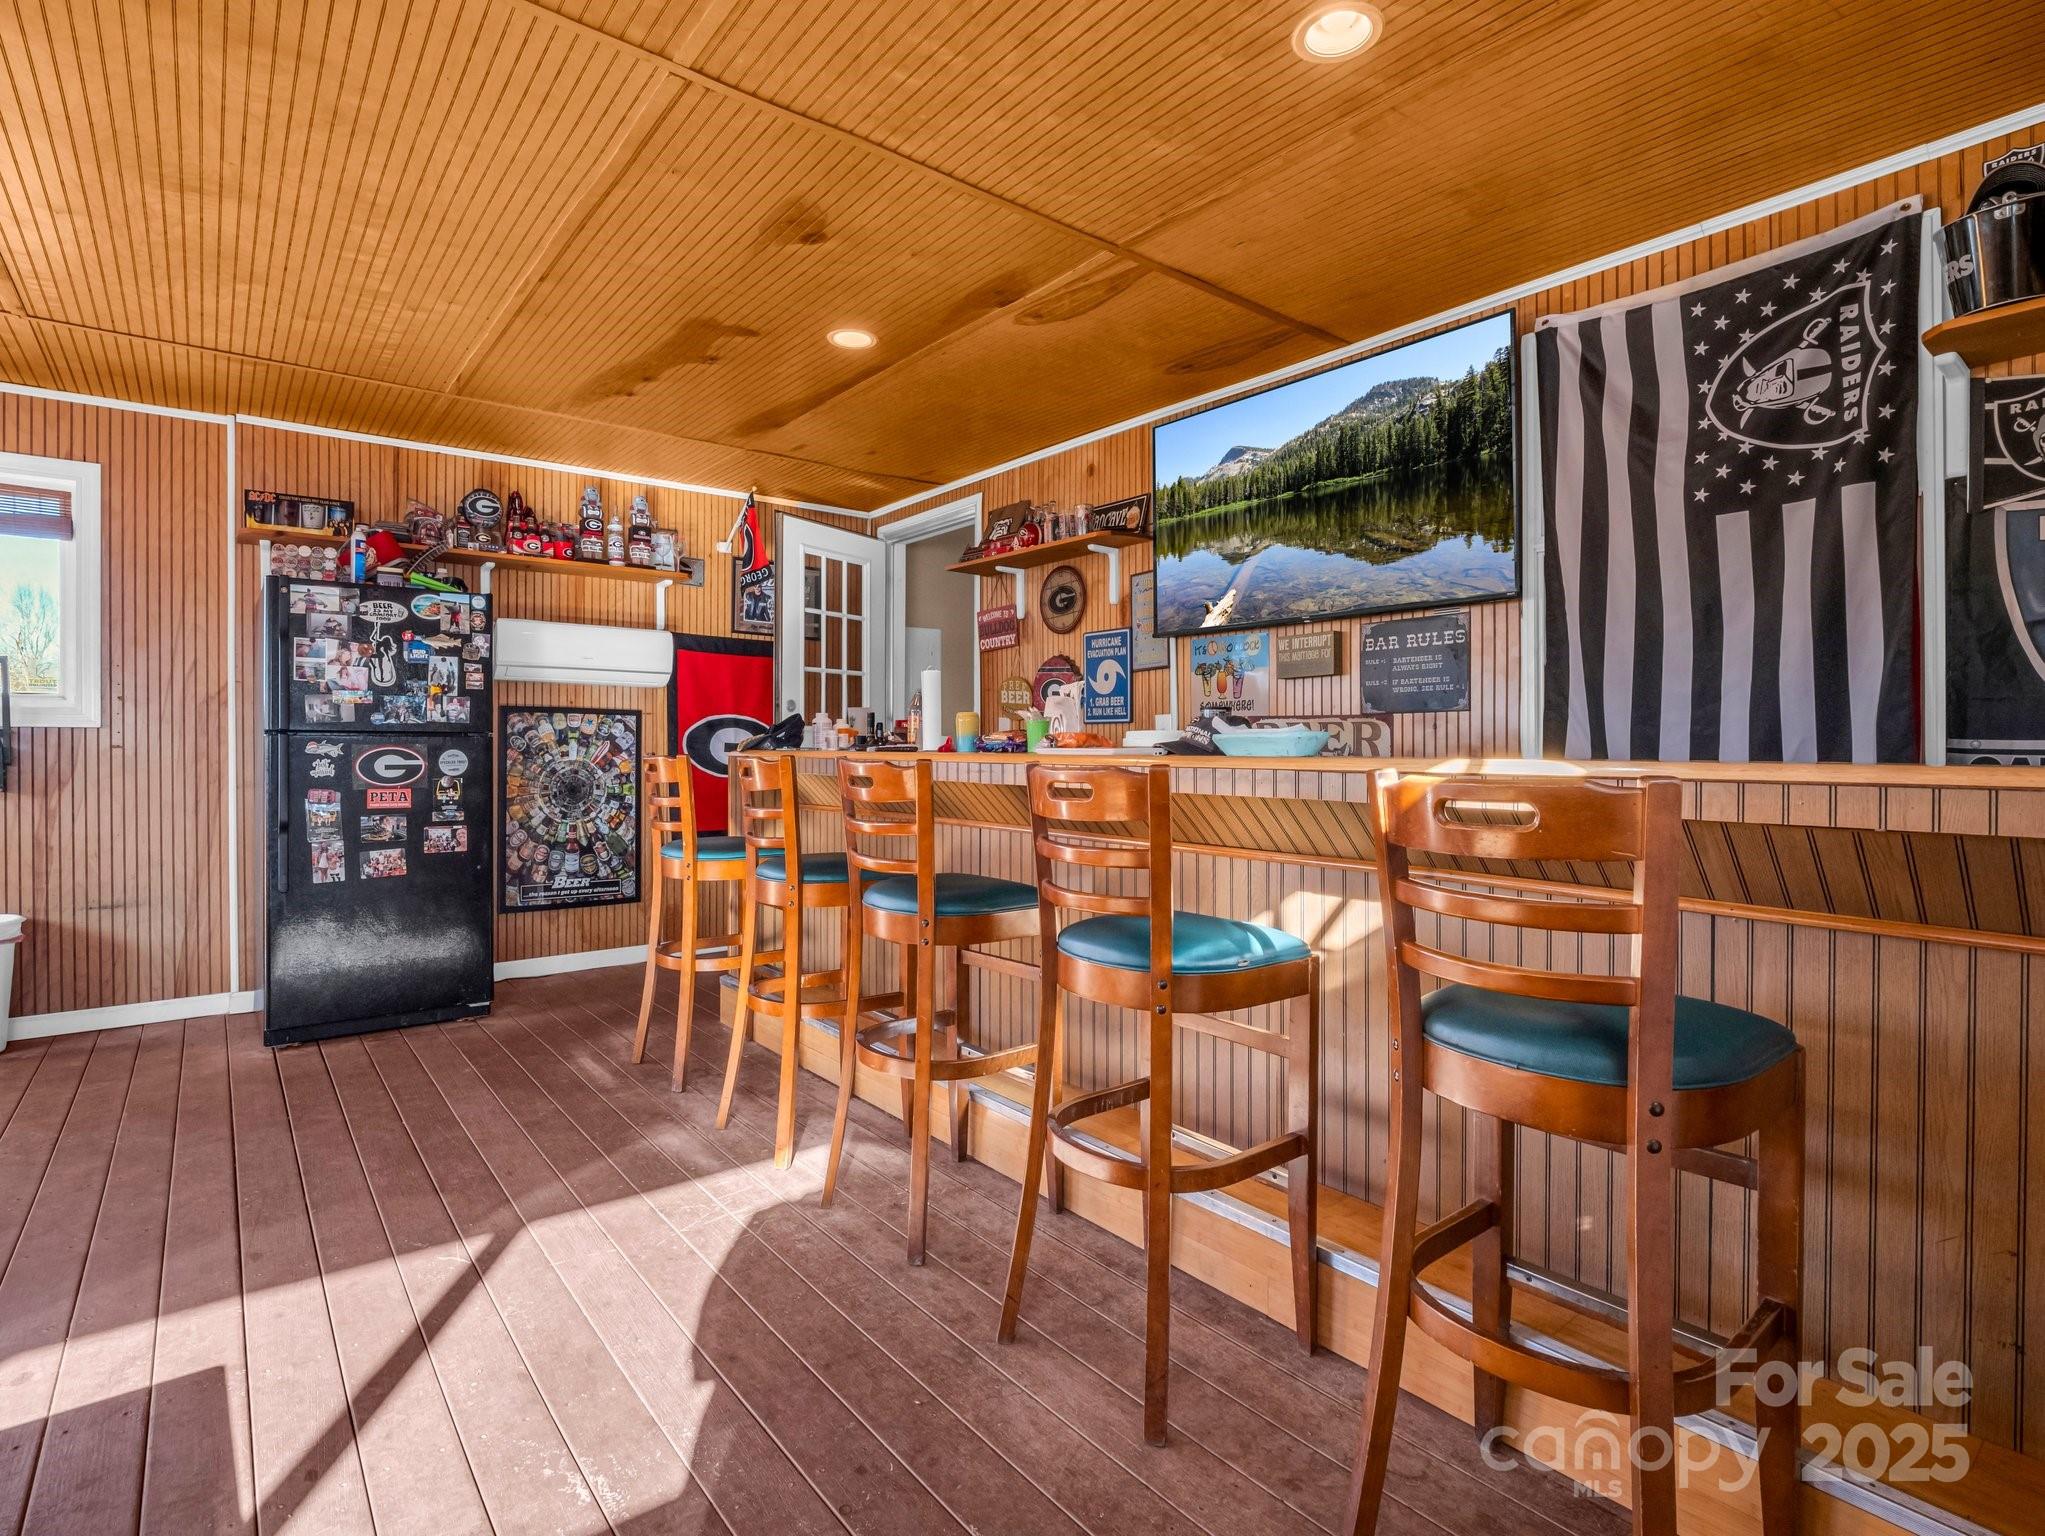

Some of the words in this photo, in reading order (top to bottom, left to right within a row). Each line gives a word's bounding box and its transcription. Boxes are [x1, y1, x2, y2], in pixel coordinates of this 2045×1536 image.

[1991, 149, 2037, 169] RAIDERS
[1840, 303, 1861, 421] RAIDERS
[249, 491, 277, 503] AC/DC
[372, 602, 393, 610] BEER
[983, 610, 1002, 622] WELCOME
[980, 634, 1016, 650] COUNTRY
[1091, 636, 1122, 649] HURRICANE
[1278, 639, 1290, 651] WE
[1291, 633, 1332, 650] INTERRUPT
[1365, 635, 1400, 652] BAR
[1406, 629, 1466, 648] RULES
[1087, 648, 1115, 659] EVACUATION
[1114, 646, 1127, 656] PLAN
[1392, 663, 1420, 672] ALWAYS
[1002, 680, 1028, 691] FREE
[1001, 690, 1030, 704] BEER
[1095, 697, 1110, 707] GRAB
[1110, 696, 1124, 706] BEER
[1103, 707, 1114, 716] LIKE
[1114, 706, 1127, 716] HELL
[370, 791, 408, 802] PETA
[552, 876, 591, 889] BEER
